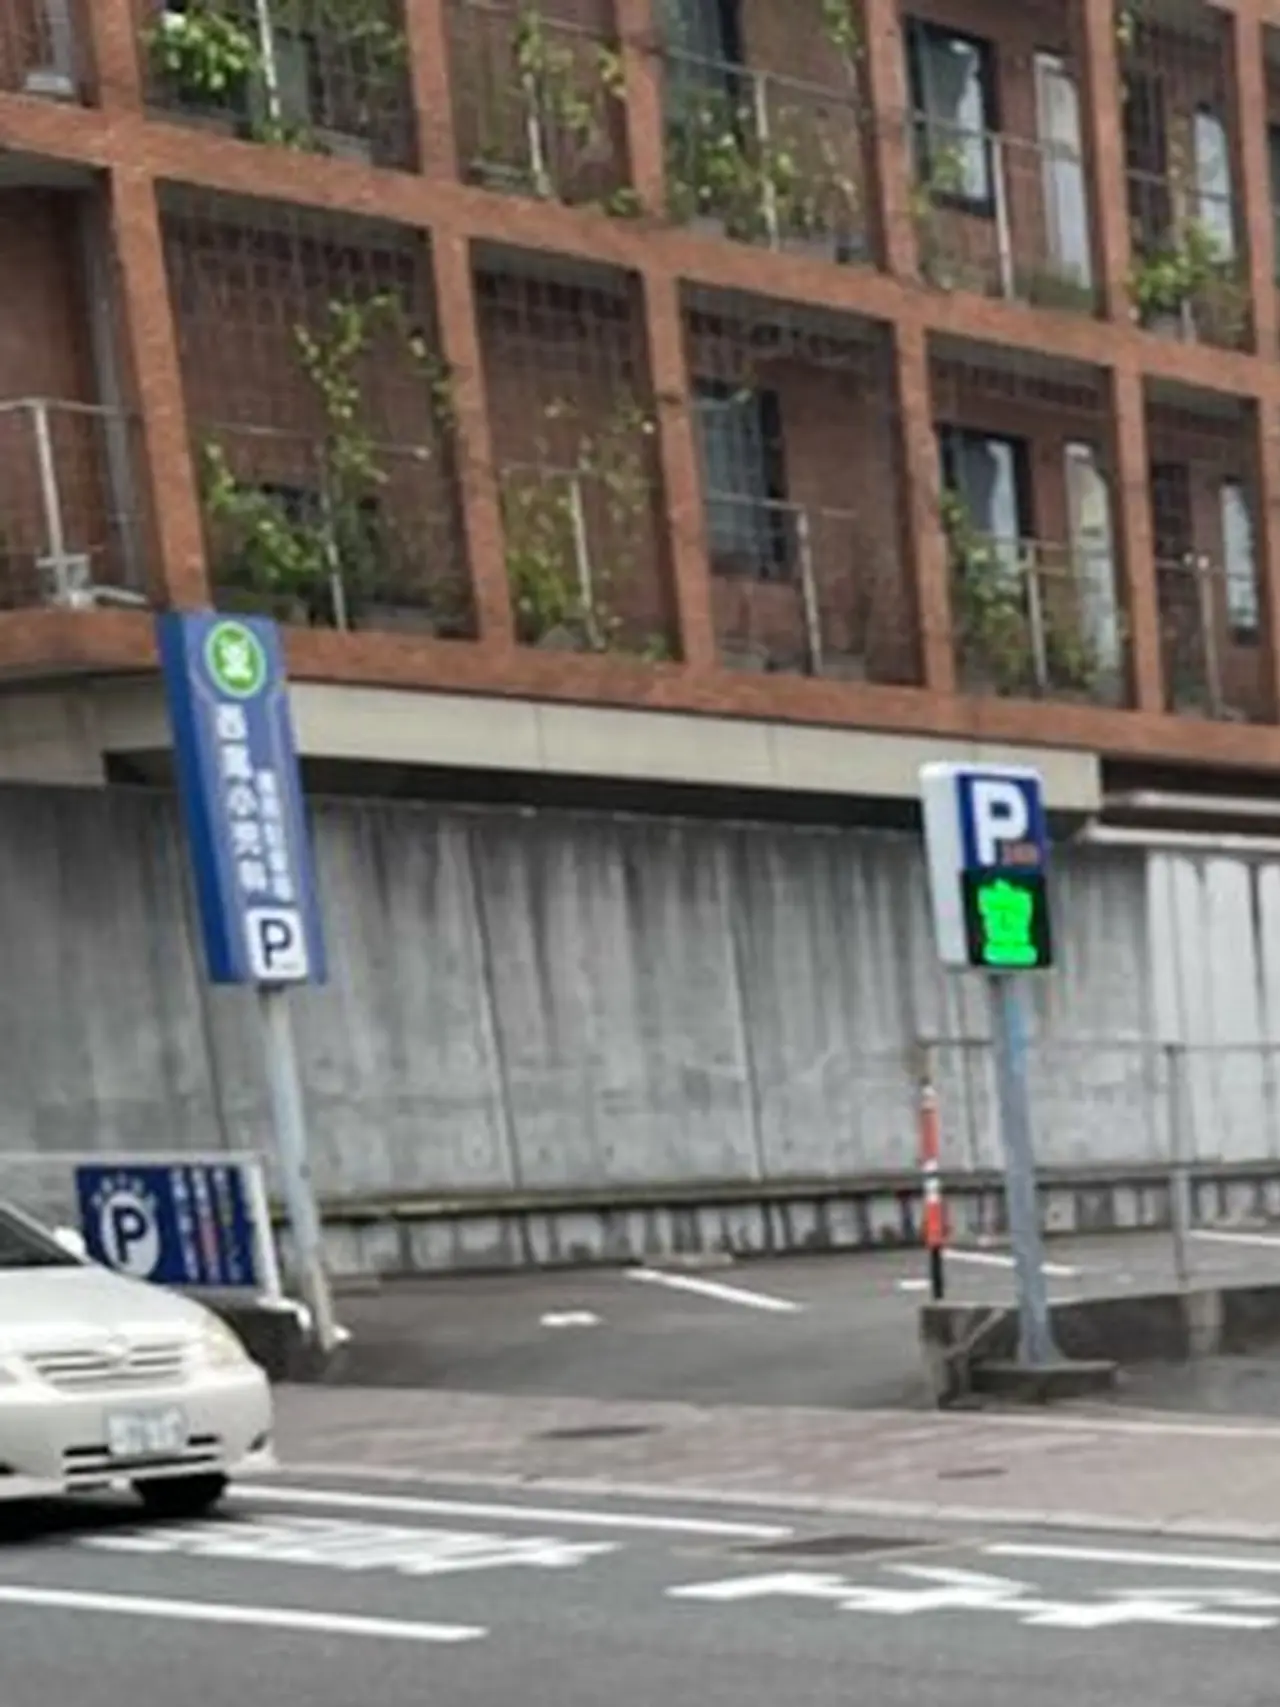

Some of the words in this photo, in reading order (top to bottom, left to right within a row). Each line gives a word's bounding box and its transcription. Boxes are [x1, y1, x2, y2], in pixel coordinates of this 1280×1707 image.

[970, 779, 1029, 866] P
[258, 917, 292, 970] P
[111, 1205, 148, 1265] P
